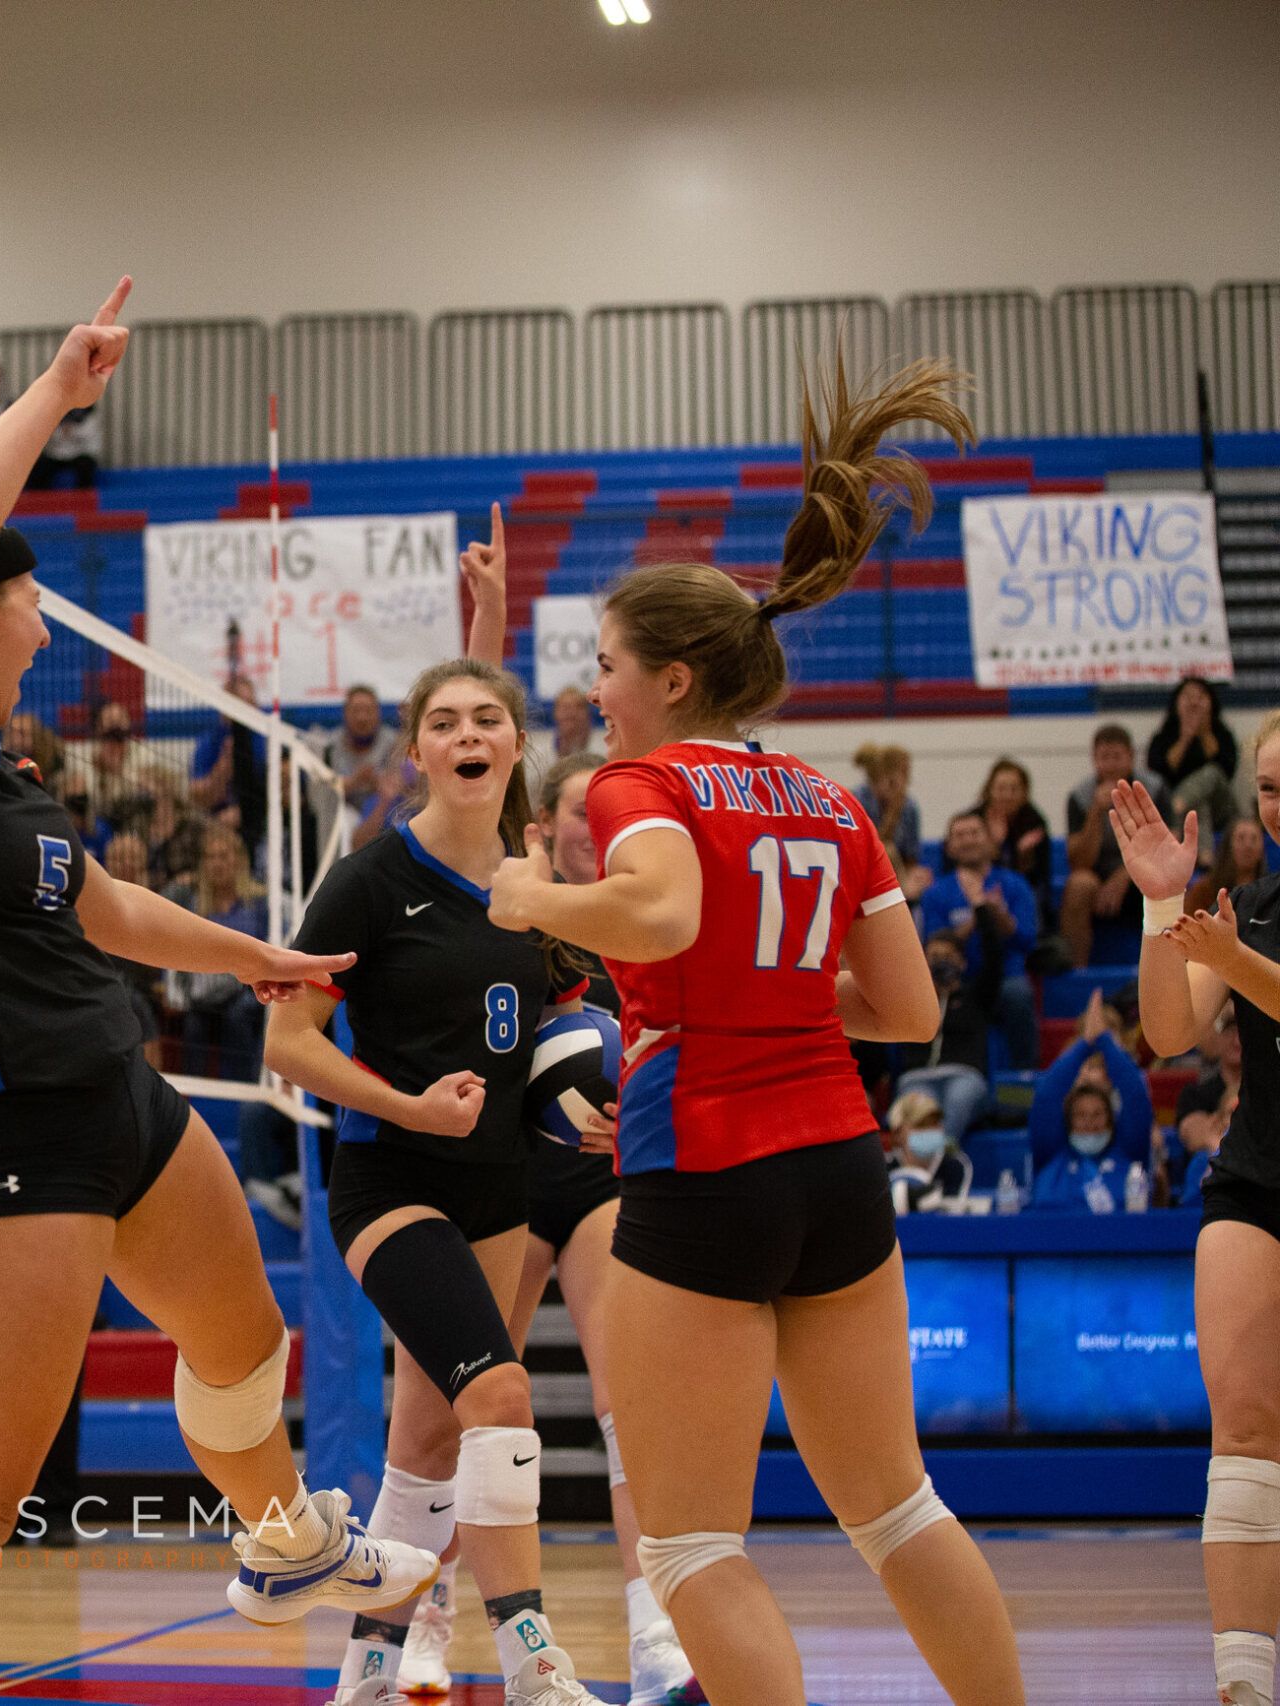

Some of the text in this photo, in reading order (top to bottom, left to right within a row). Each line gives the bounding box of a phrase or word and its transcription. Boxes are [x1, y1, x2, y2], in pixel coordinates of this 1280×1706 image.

[160, 523, 444, 581] VIKING FAN
[988, 503, 1202, 566] VIKING
[998, 565, 1210, 632] STRONG
[670, 762, 859, 830] VIKINGS
[36, 834, 72, 911] 5
[748, 833, 841, 972] 17
[485, 982, 519, 1053] 8
